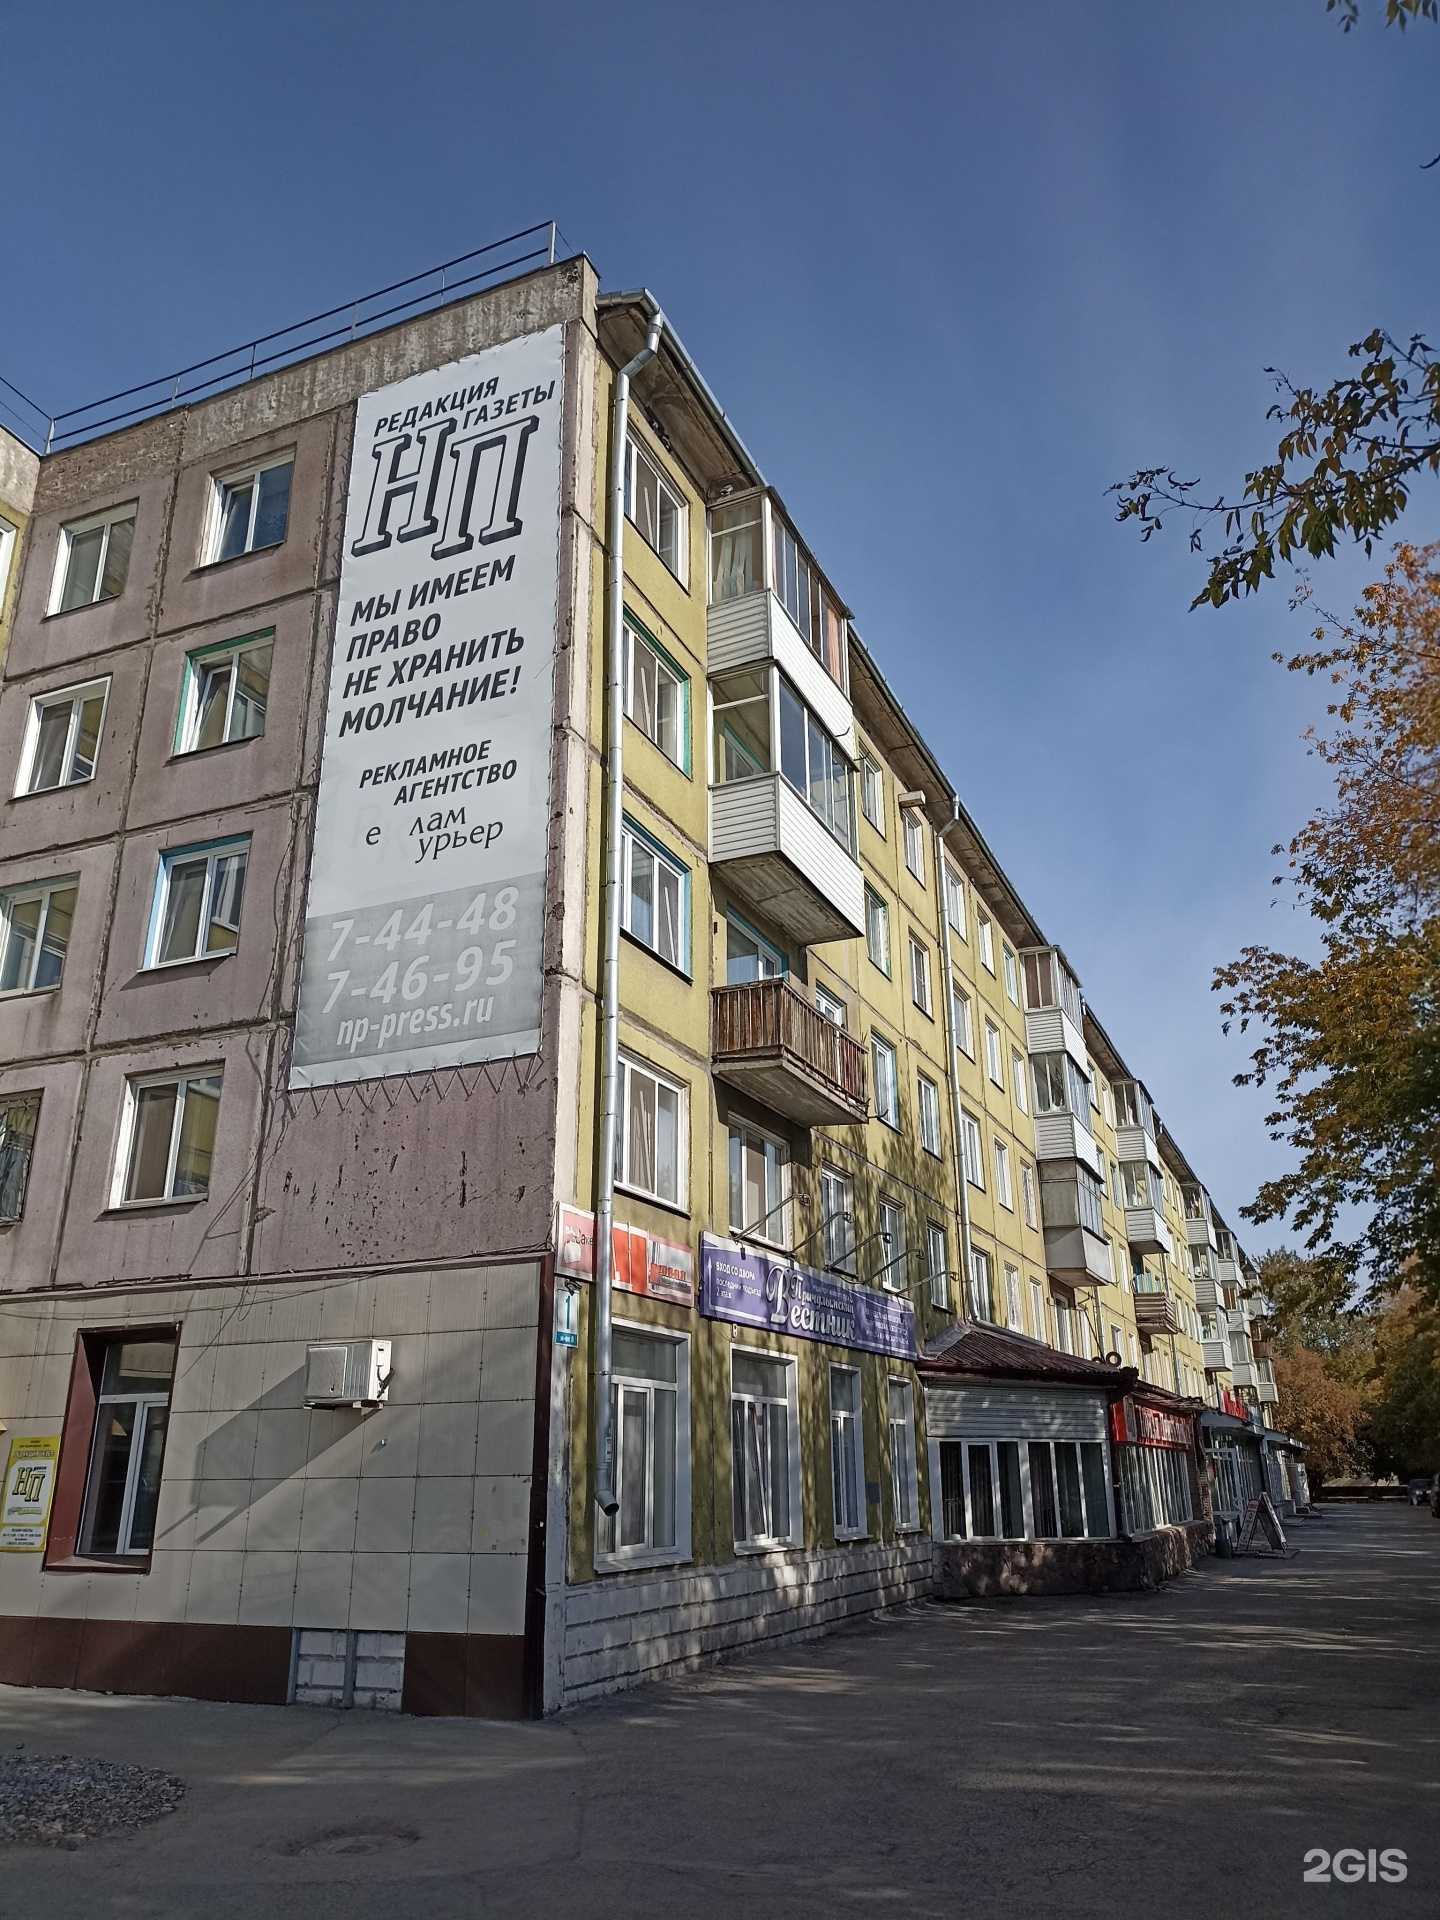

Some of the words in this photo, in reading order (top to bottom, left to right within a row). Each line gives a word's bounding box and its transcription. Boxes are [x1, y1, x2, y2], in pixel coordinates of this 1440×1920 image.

[374, 376, 499, 437] РЕДАКЦИЯ
[462, 381, 555, 430] ГАЗЕТЫ
[351, 415, 540, 561] НП
[350, 589, 399, 627] МЫ
[407, 554, 516, 611] ИМЕЕМ
[342, 662, 381, 699] НЕ
[387, 626, 525, 688] ХРАНИТЬ
[346, 612, 442, 662] ПРАВО
[339, 665, 522, 738] МОЛЧАНИЕ!
[359, 739, 493, 788] РЕКЛАМНОЕ
[393, 759, 518, 806] АГЕНТСТВО
[415, 820, 504, 864] урьер
[327, 886, 520, 962] 7-44-48
[321, 939, 518, 1014] 7-46-95
[336, 995, 495, 1053] np-press.ru
[715, 1261, 731, 1275] ВХОД
[12, 1466, 46, 1503] НП
